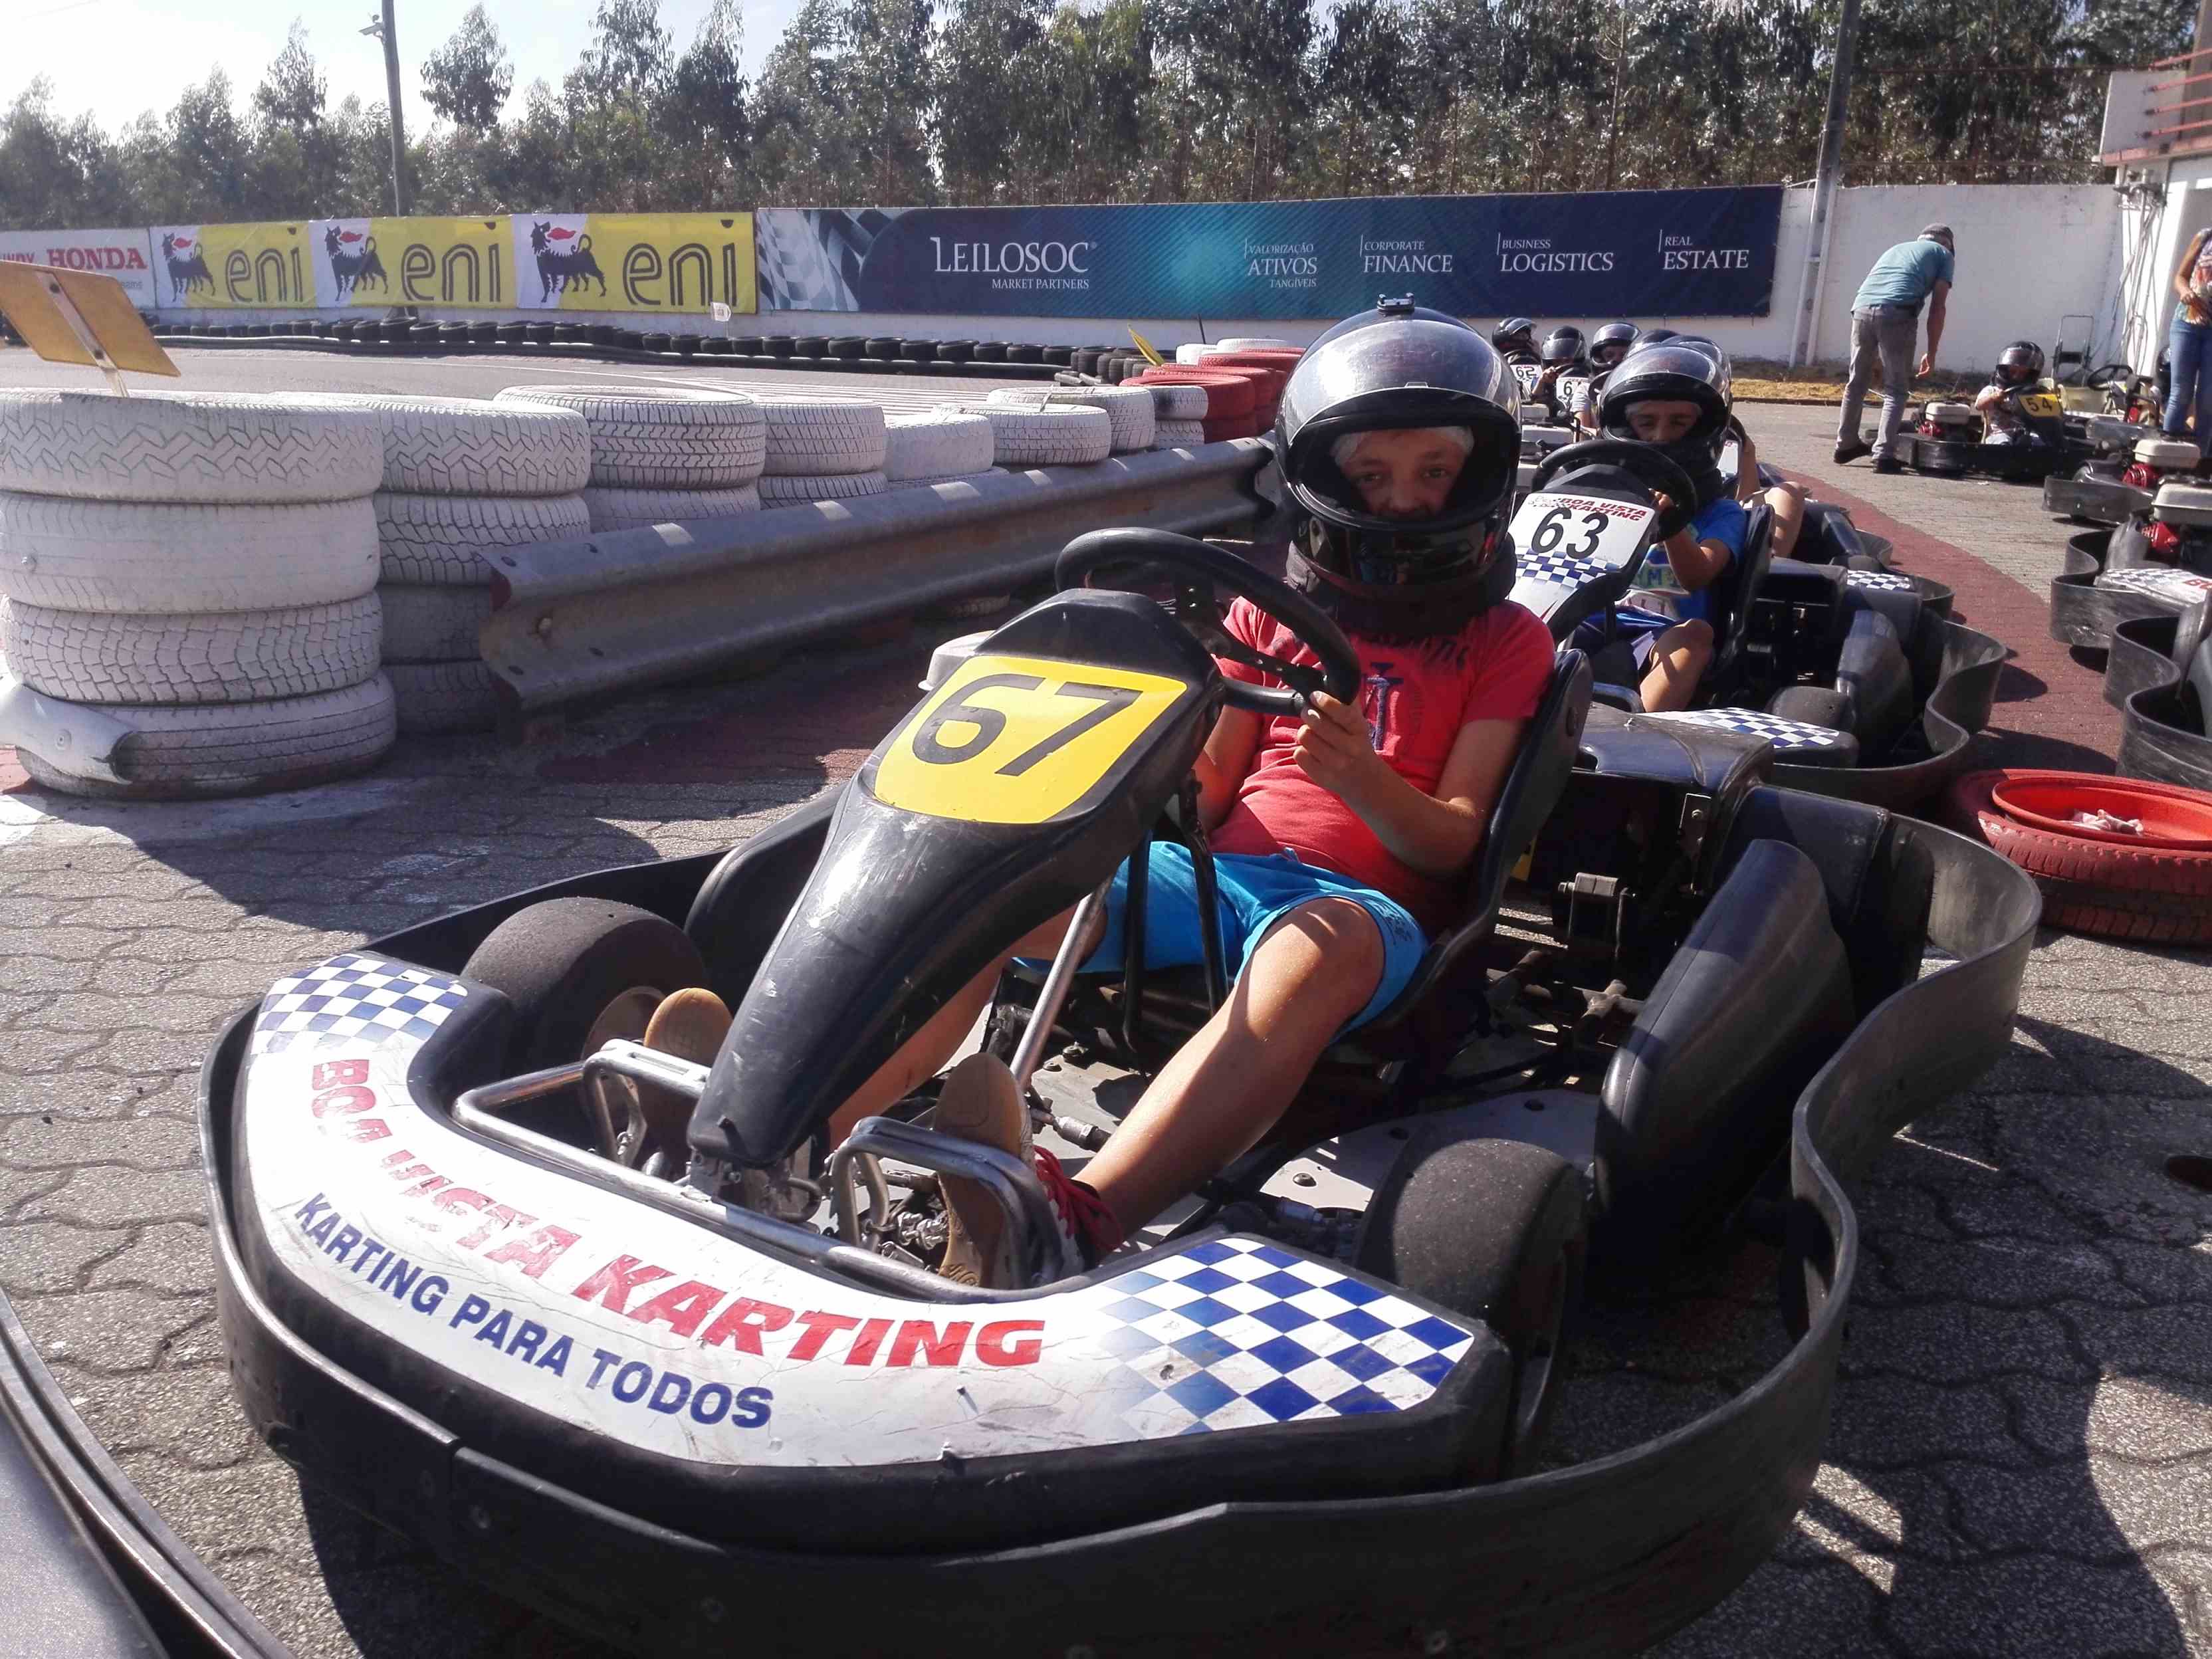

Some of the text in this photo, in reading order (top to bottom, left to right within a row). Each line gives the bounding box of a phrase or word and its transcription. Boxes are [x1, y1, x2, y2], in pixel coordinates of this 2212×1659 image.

[1250, 243, 1314, 255] VALORIZAÇÃO
[1364, 241, 1425, 251] CORPORATE
[1501, 239, 1551, 249] BUSINESS
[1664, 236, 1693, 247] REAL
[47, 247, 148, 269] HONDA
[225, 227, 304, 302] eni
[401, 222, 500, 302] eni
[623, 219, 737, 306] eni
[931, 237, 1089, 273] LEILOSOC
[1363, 255, 1453, 273] FINANCE
[1501, 252, 1614, 272] LOGISTICS
[1663, 249, 1749, 270] ESTATE
[1248, 257, 1317, 276] ATIVOS
[992, 278, 1089, 290] MARKET PARTNERS
[1515, 366, 1537, 379] 62
[2025, 397, 2053, 411] 54
[1600, 502, 1647, 516] VISTA
[1531, 506, 1609, 560] 63
[912, 673, 1144, 776] 67
[294, 1192, 774, 1428] KARTING PARA TODOS
[571, 1254, 1046, 1368] KARTING
